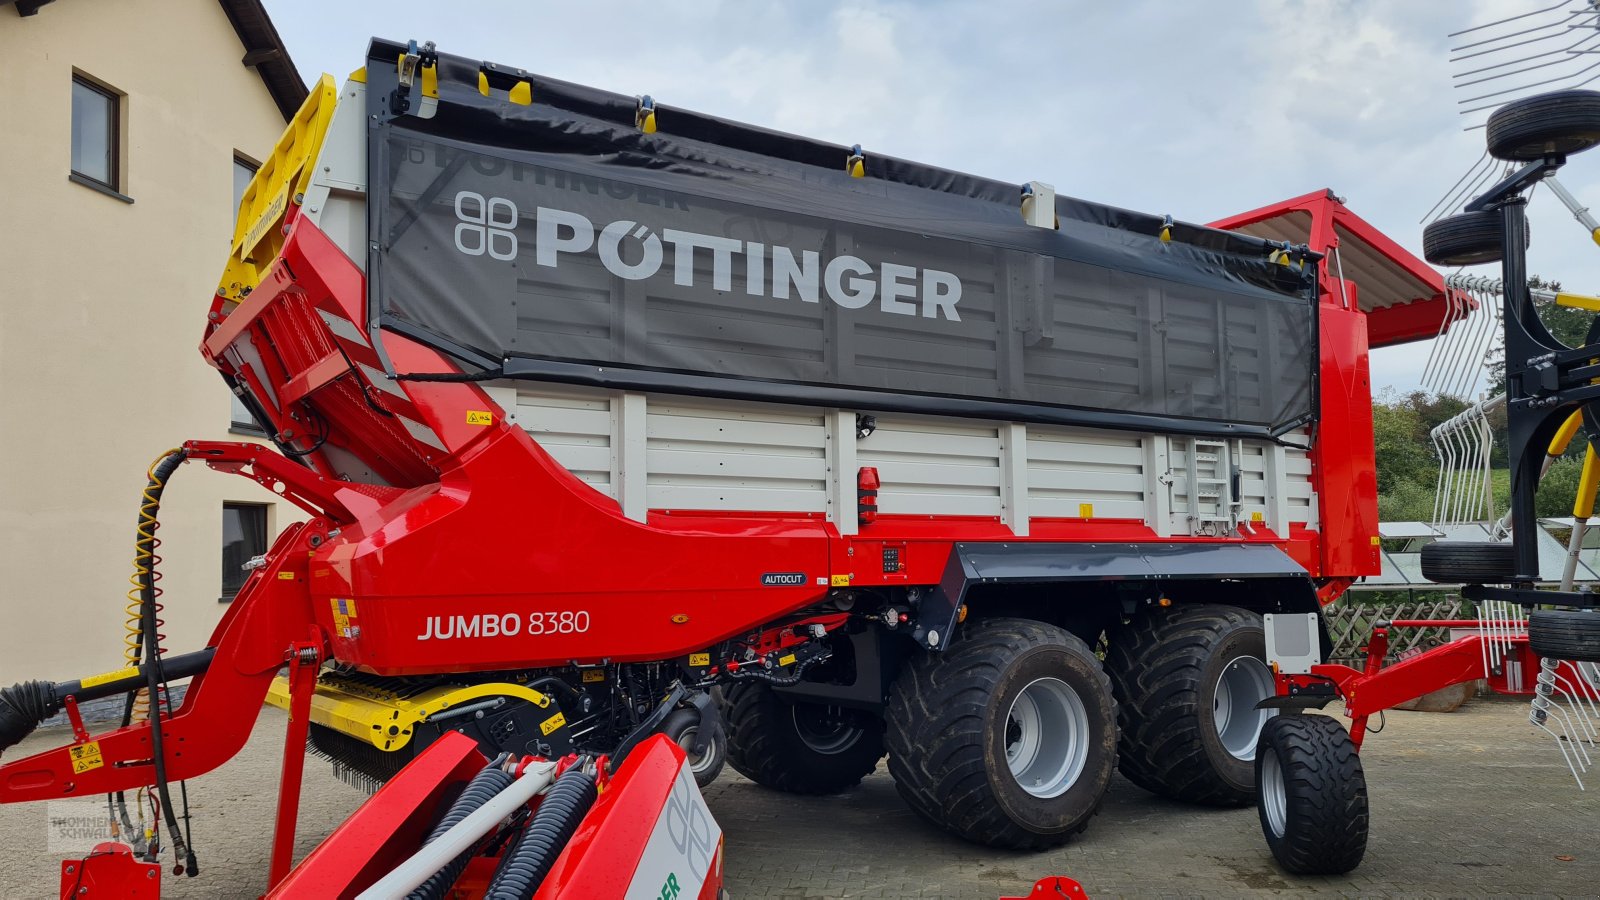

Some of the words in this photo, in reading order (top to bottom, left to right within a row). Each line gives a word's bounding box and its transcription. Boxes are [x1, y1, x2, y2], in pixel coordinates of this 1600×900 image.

[536, 206, 962, 322] PÖTTINGER
[765, 574, 803, 584] AUTOCUT
[417, 613, 521, 641] JUMBO
[528, 610, 590, 635] 8380
